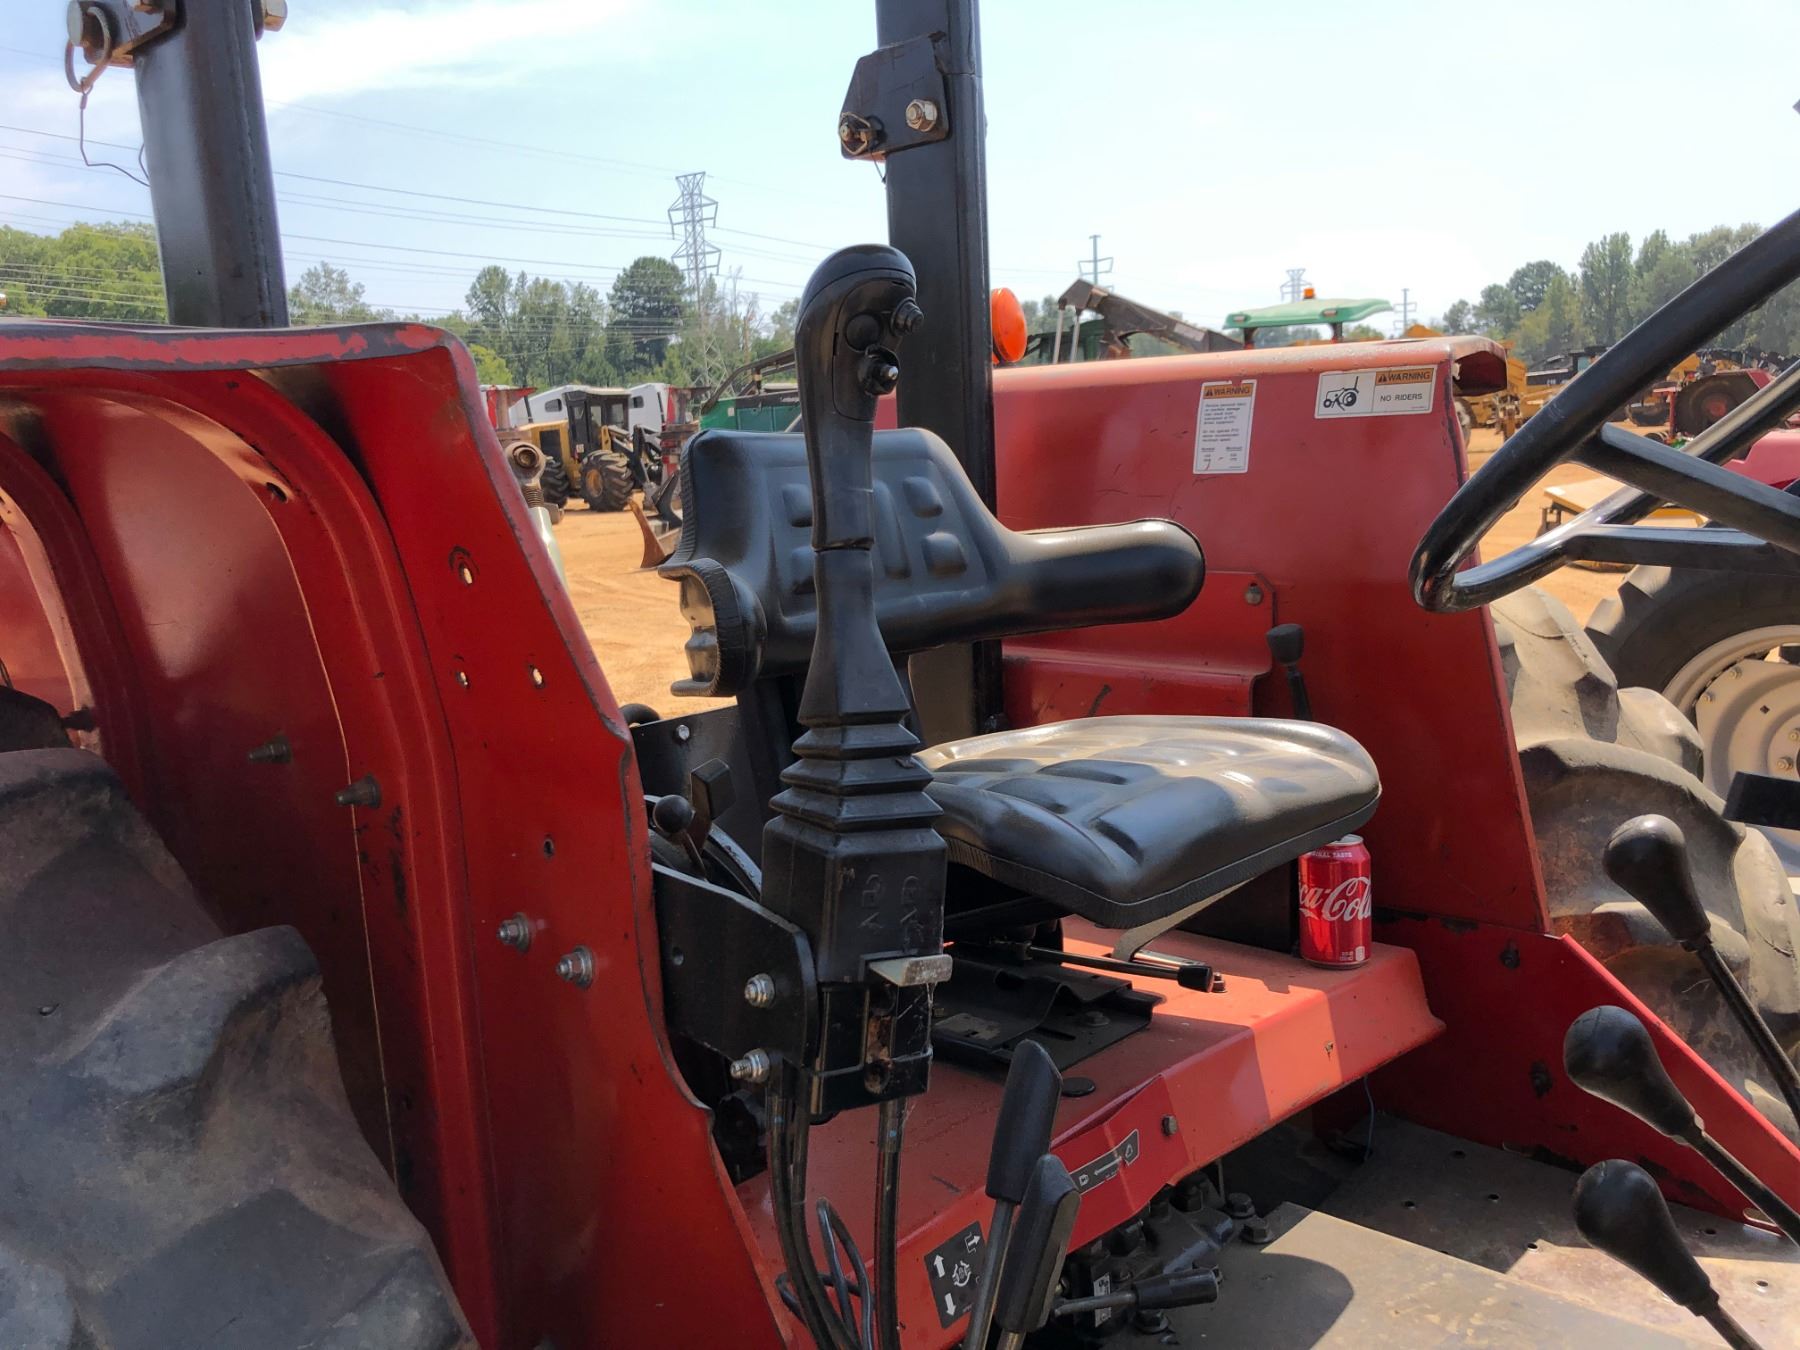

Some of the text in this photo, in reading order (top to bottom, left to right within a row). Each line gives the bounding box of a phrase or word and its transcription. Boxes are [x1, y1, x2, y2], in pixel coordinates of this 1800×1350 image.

[1388, 371, 1431, 382] WARNING
[1214, 386, 1250, 396] WARNING
[1380, 393, 1423, 402] NO RIDERS
